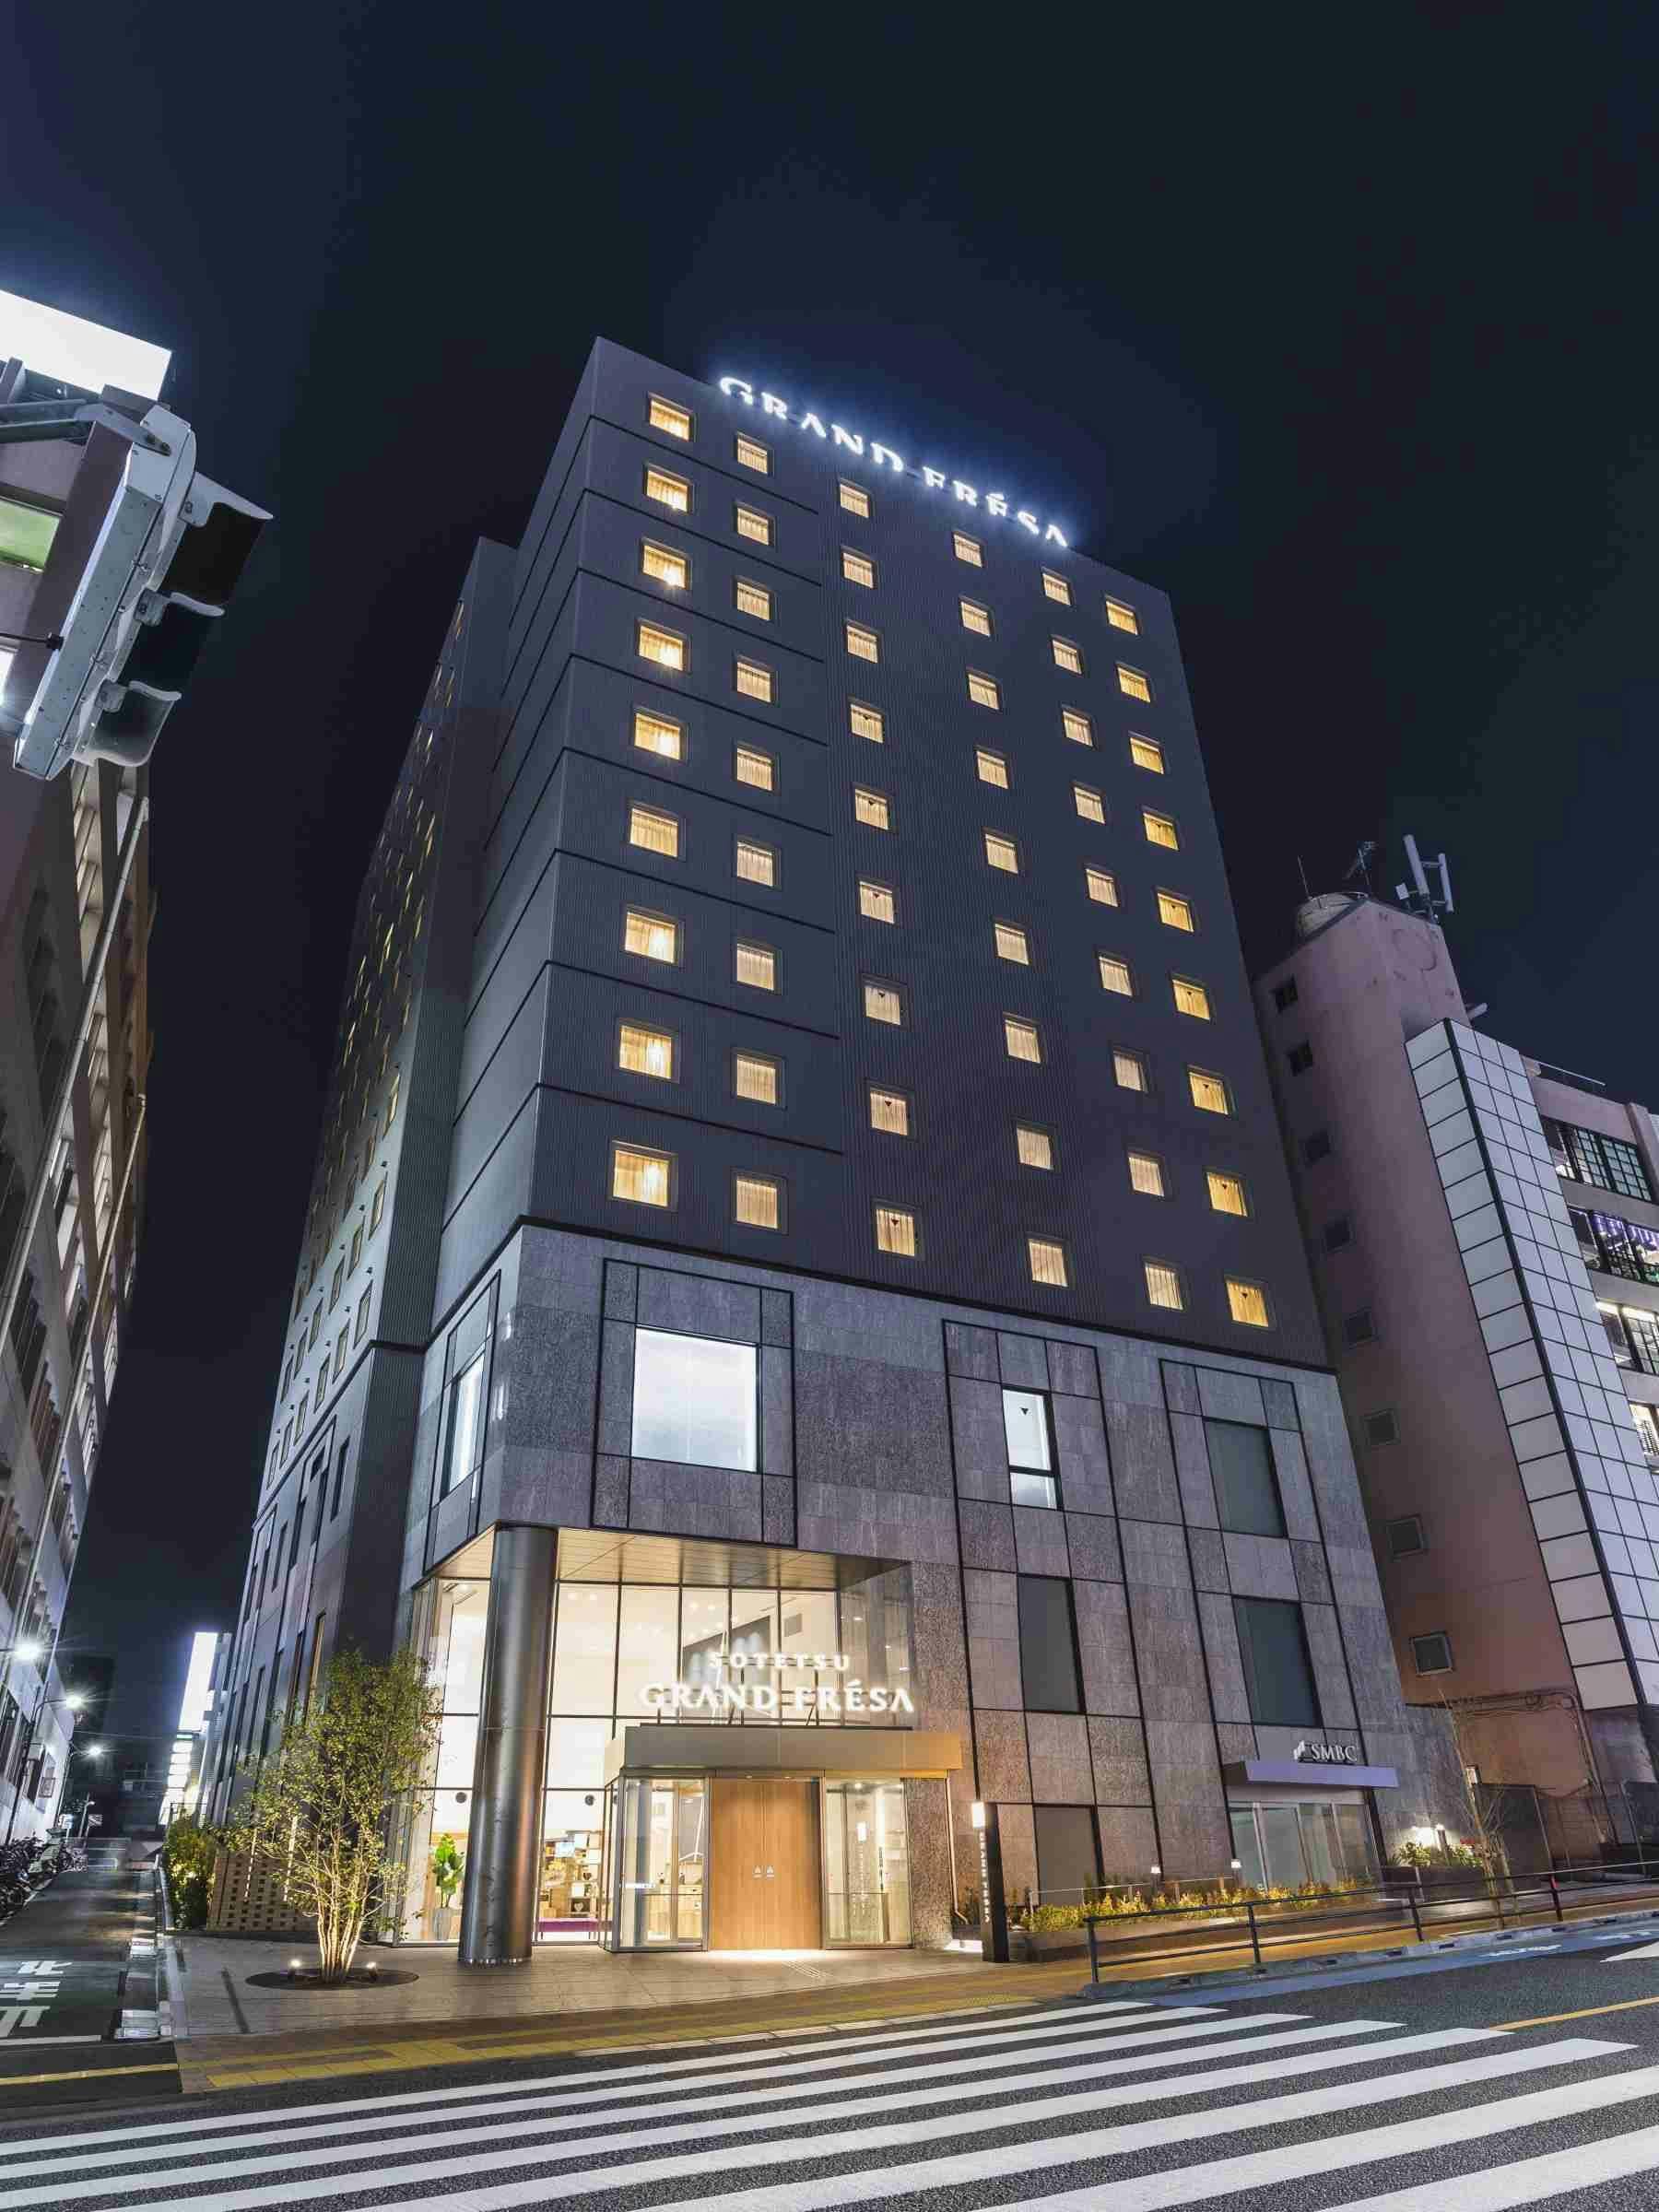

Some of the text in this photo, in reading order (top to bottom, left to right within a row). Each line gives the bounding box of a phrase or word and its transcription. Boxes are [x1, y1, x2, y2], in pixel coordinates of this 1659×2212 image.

[719, 376, 904, 473] GRAND
[708, 1652, 850, 1671] SOTETSU
[640, 1678, 914, 1712] GRAND FRÉSA
[1311, 1743, 1358, 1762] SMBC
